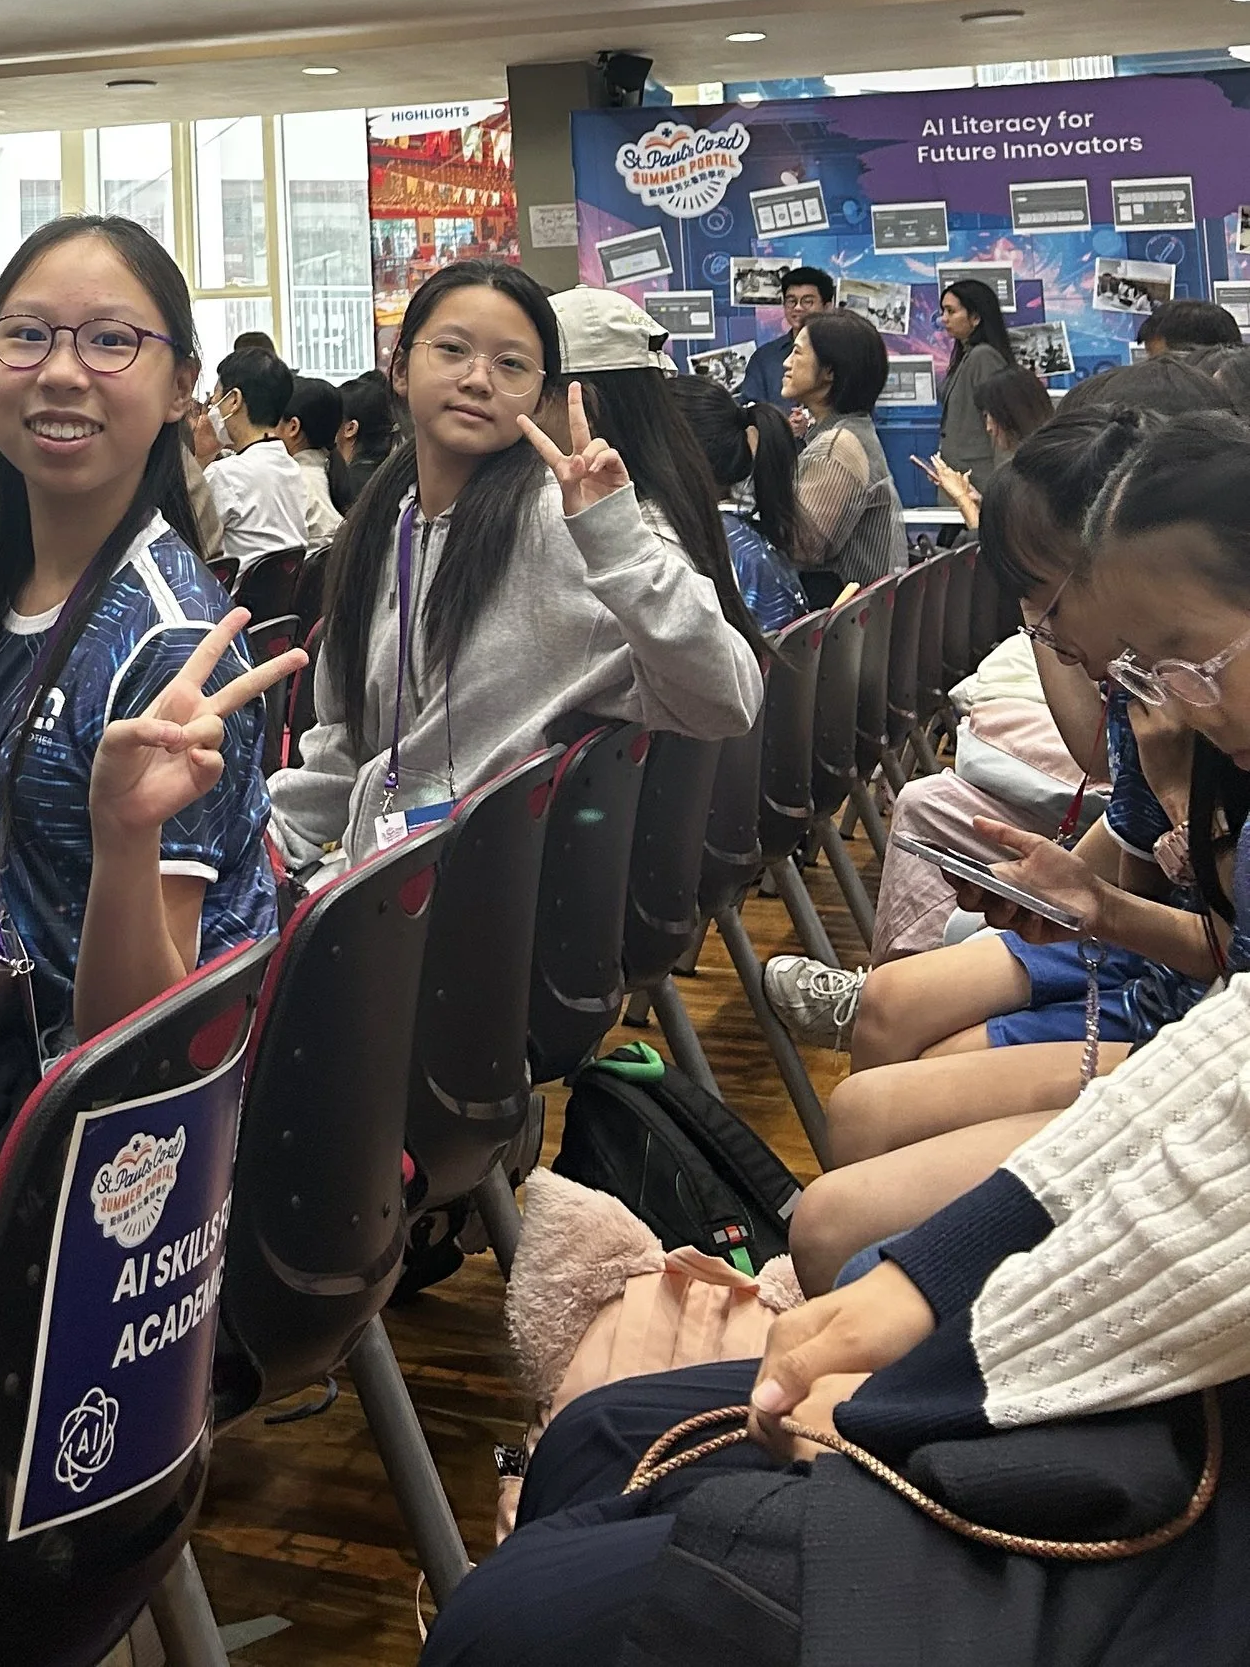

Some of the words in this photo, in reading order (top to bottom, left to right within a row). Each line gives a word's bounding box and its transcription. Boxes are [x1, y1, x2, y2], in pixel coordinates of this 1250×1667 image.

[391, 106, 470, 122] HIGHLIGHTS
[922, 118, 944, 137] AI
[951, 114, 1051, 136] Literacy
[1058, 110, 1094, 130] for
[646, 144, 694, 169] Paul's
[695, 129, 744, 152] Co-ed
[917, 142, 997, 164] Future
[1003, 135, 1143, 160] Innovators
[633, 166, 686, 186] SUMMER
[690, 152, 737, 174] PORTAL
[100, 1184, 142, 1213] SUMMER
[144, 1163, 174, 1192] PORTAL
[114, 1157, 153, 1192] Paul's
[111, 1252, 150, 1303] AI
[154, 1211, 220, 1291] SKILLS
[77, 1432, 100, 1456] AI
